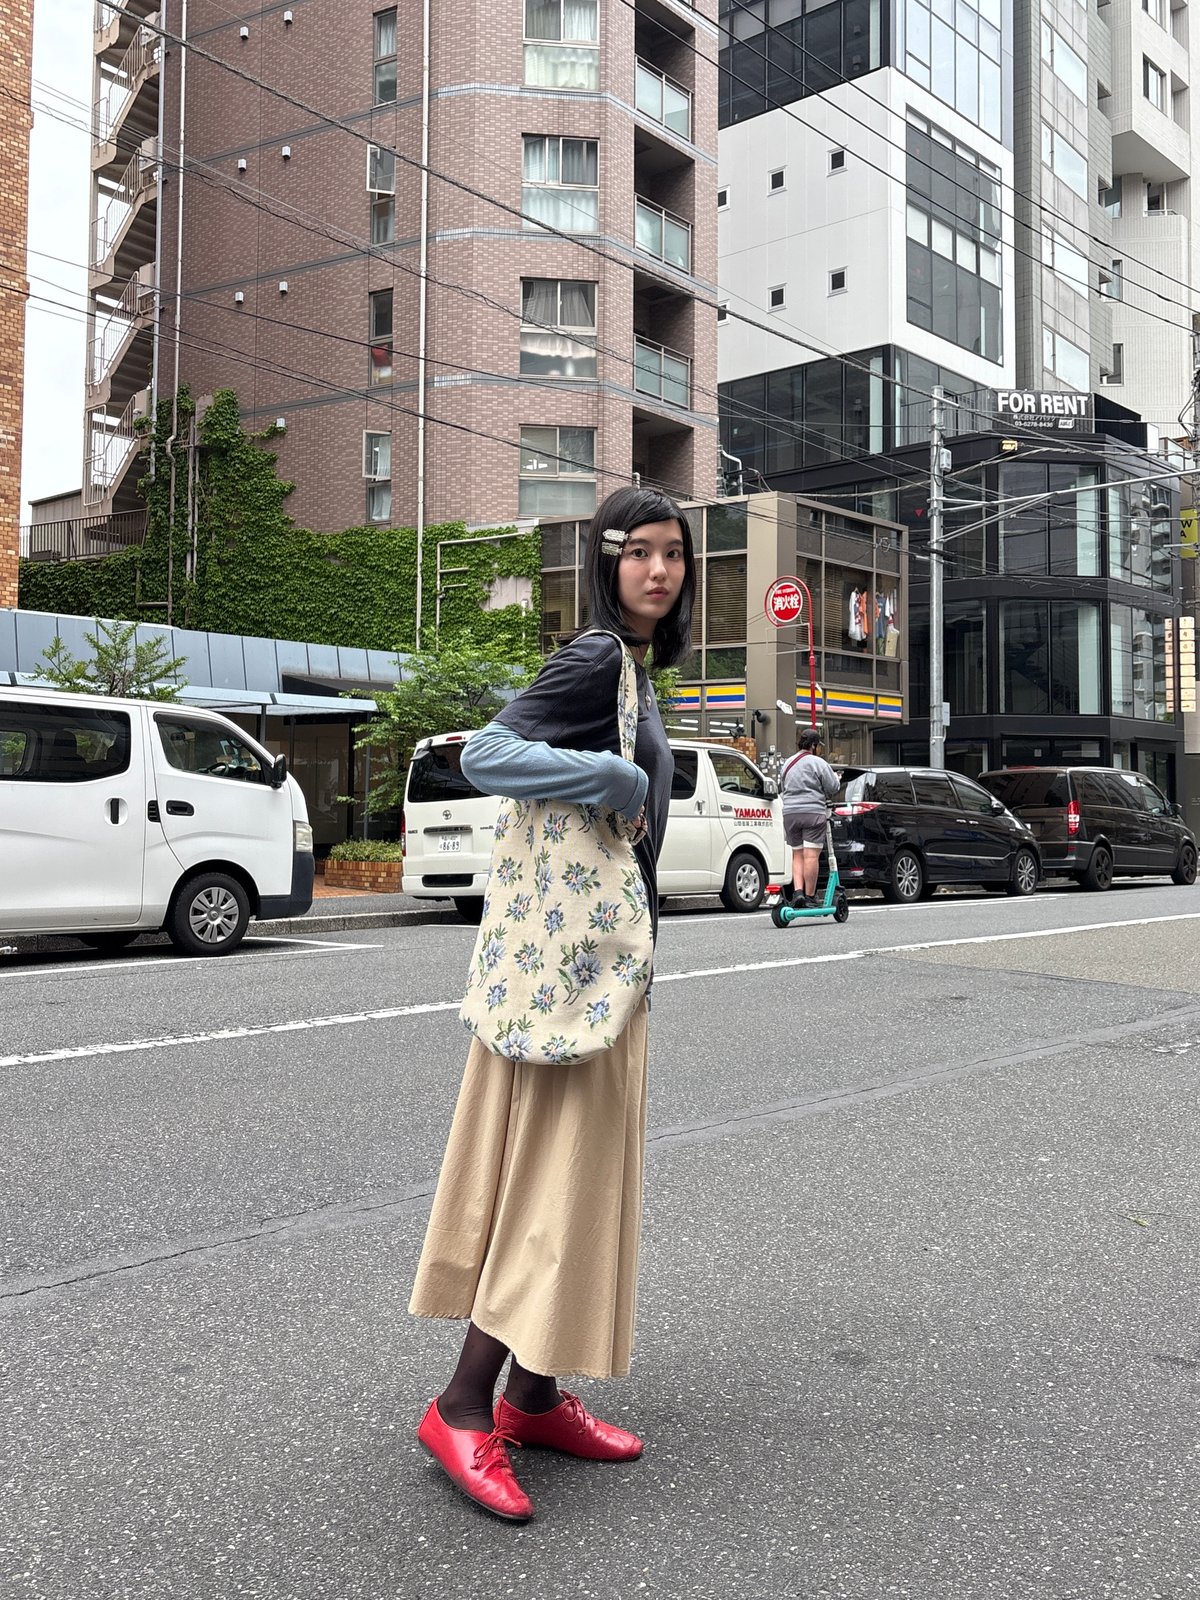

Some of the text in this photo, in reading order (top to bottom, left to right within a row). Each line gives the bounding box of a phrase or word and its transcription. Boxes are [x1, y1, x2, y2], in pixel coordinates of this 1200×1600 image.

[997, 392, 1089, 416] FOR RENT
[773, 593, 800, 612] 消火栓
[733, 807, 773, 819] YAMAOKA
